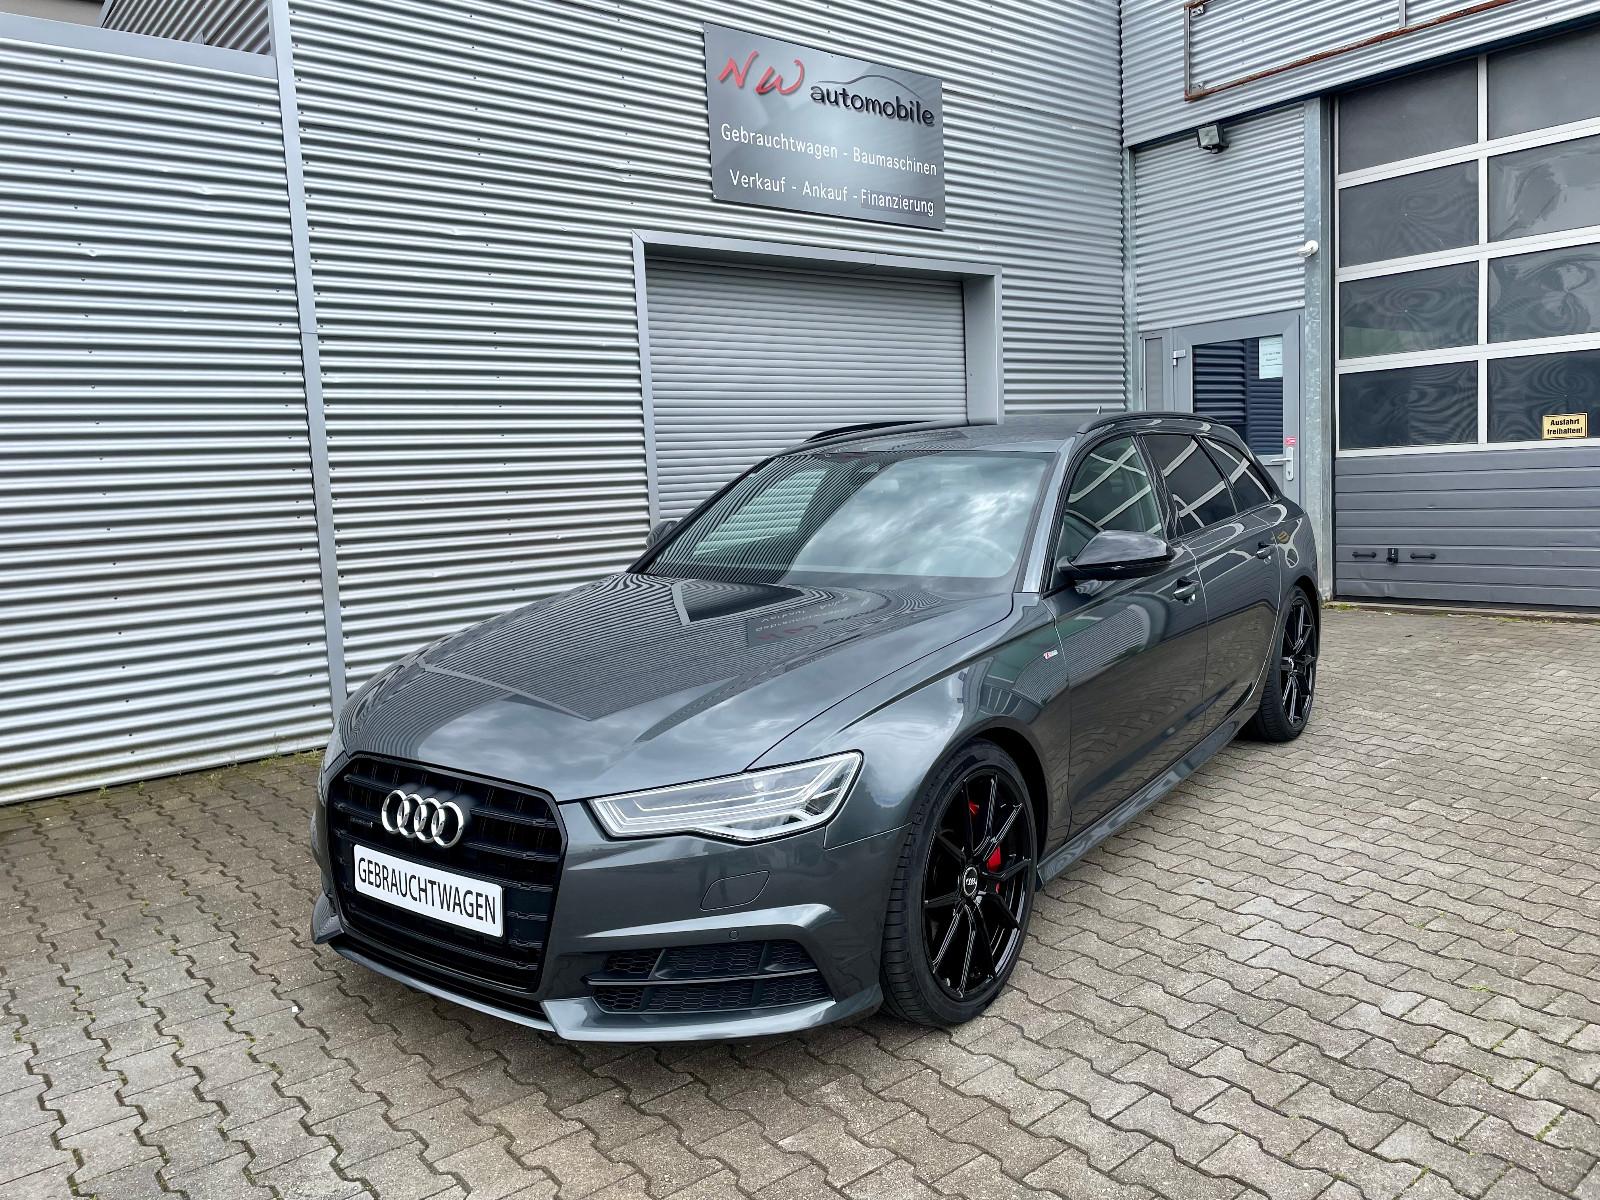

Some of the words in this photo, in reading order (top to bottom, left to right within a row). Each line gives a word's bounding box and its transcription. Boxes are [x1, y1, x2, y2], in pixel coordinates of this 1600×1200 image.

[810, 85, 935, 127] automobile
[721, 123, 838, 159] Gebrauchtwagen
[853, 147, 937, 175] Baumaschinen
[729, 169, 786, 193] Verkauf
[802, 181, 848, 201] Ankauf
[861, 188, 934, 216] Finanzierung
[1550, 418, 1580, 426] Ausfahrt
[358, 857, 496, 925] GEBRAUCHTWAGEN
